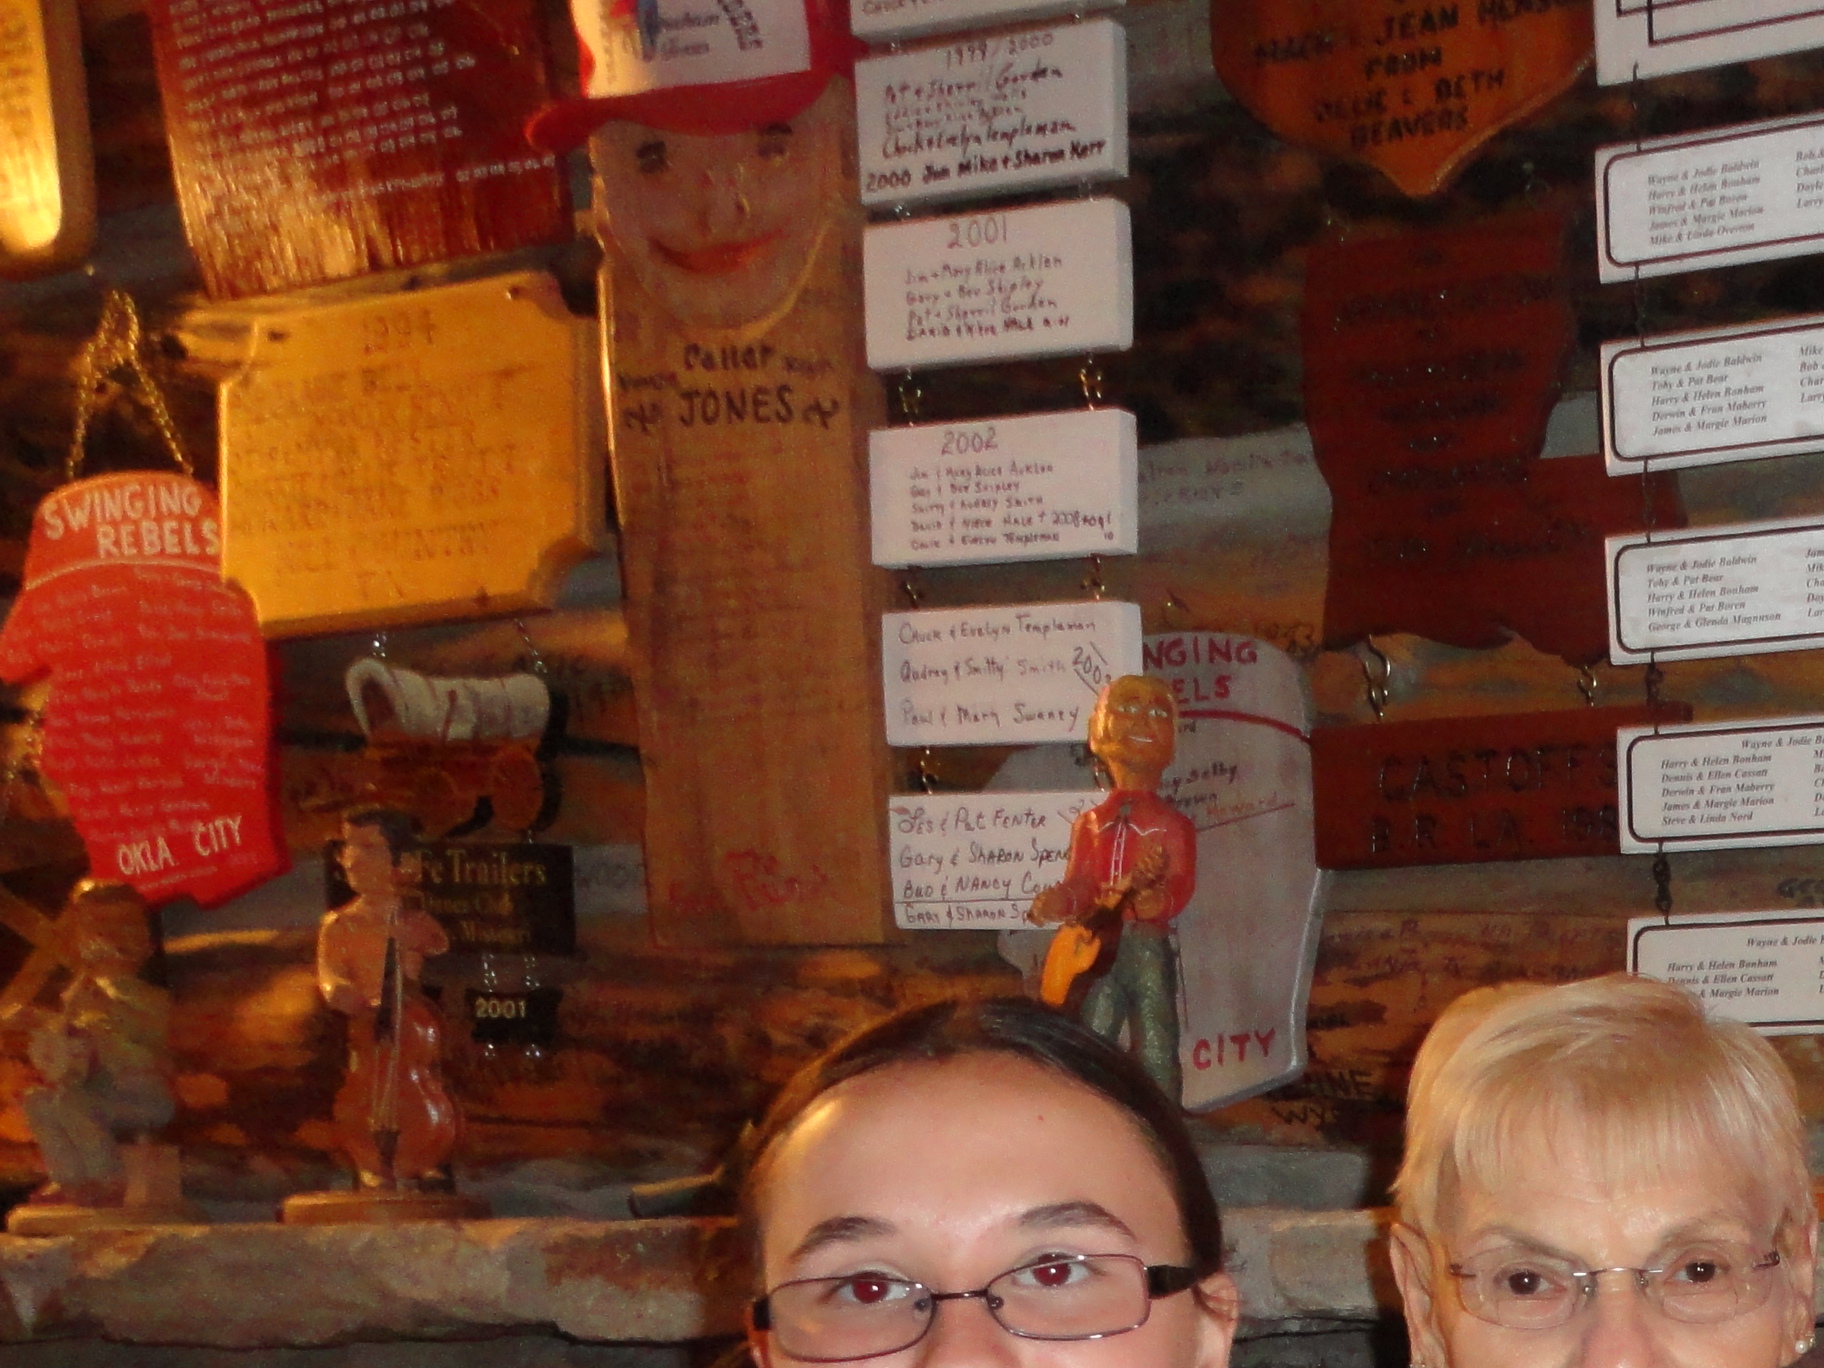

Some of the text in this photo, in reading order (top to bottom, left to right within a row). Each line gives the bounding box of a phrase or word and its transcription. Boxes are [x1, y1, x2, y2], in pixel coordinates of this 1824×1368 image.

[947, 214, 1007, 249] 2001
[679, 384, 794, 427] JONES
[941, 426, 999, 455] 2002
[42, 482, 202, 540] SWINGING
[98, 520, 220, 558] REBELS
[1015, 613, 1096, 640] Templeman
[1143, 636, 1257, 670] NGING
[1172, 675, 1232, 703] ELS
[1742, 739, 1773, 751] Wayne
[1775, 737, 1783, 747] &
[1786, 736, 1812, 746] Jodie
[1661, 753, 1772, 770] Harry & Helen Bonham
[1662, 782, 1775, 797] Derwin & Fran Maberry
[1662, 795, 1774, 812] James & Margie Marion
[954, 807, 986, 832] Pat
[117, 815, 243, 874] OKLA CITY
[476, 1000, 527, 1019] 2001
[1193, 1028, 1276, 1069] CITY
